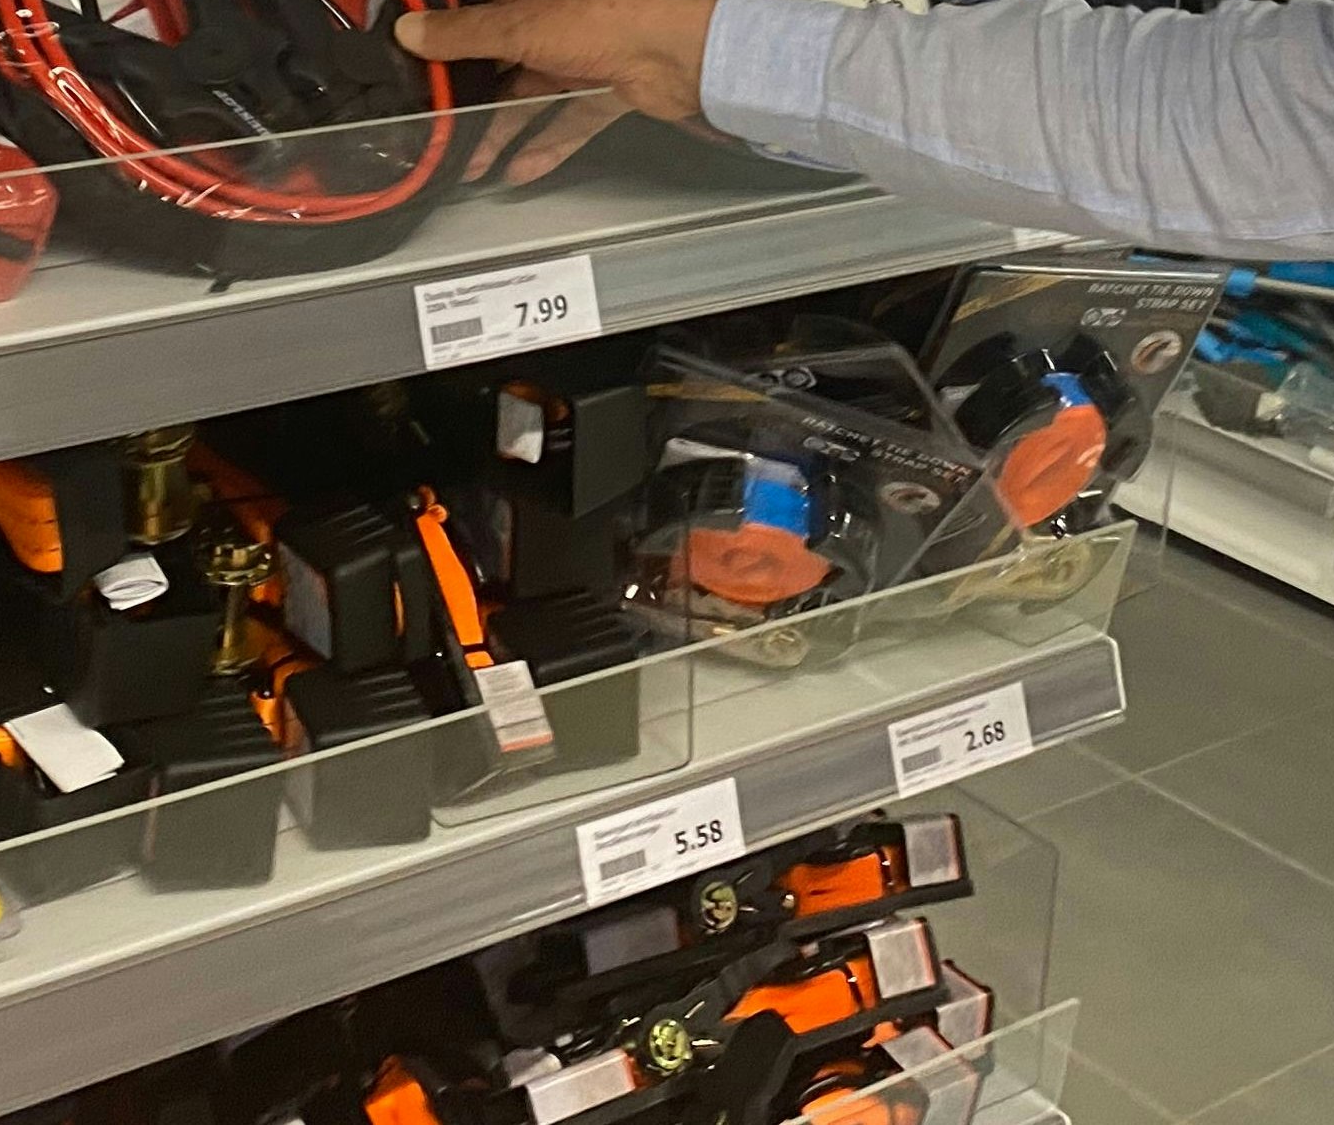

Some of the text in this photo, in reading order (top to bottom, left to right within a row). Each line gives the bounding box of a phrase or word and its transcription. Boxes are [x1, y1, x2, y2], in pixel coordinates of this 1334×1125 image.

[513, 294, 568, 329] 7.99
[963, 720, 1006, 752] 2.68
[674, 819, 723, 855] 5.58
